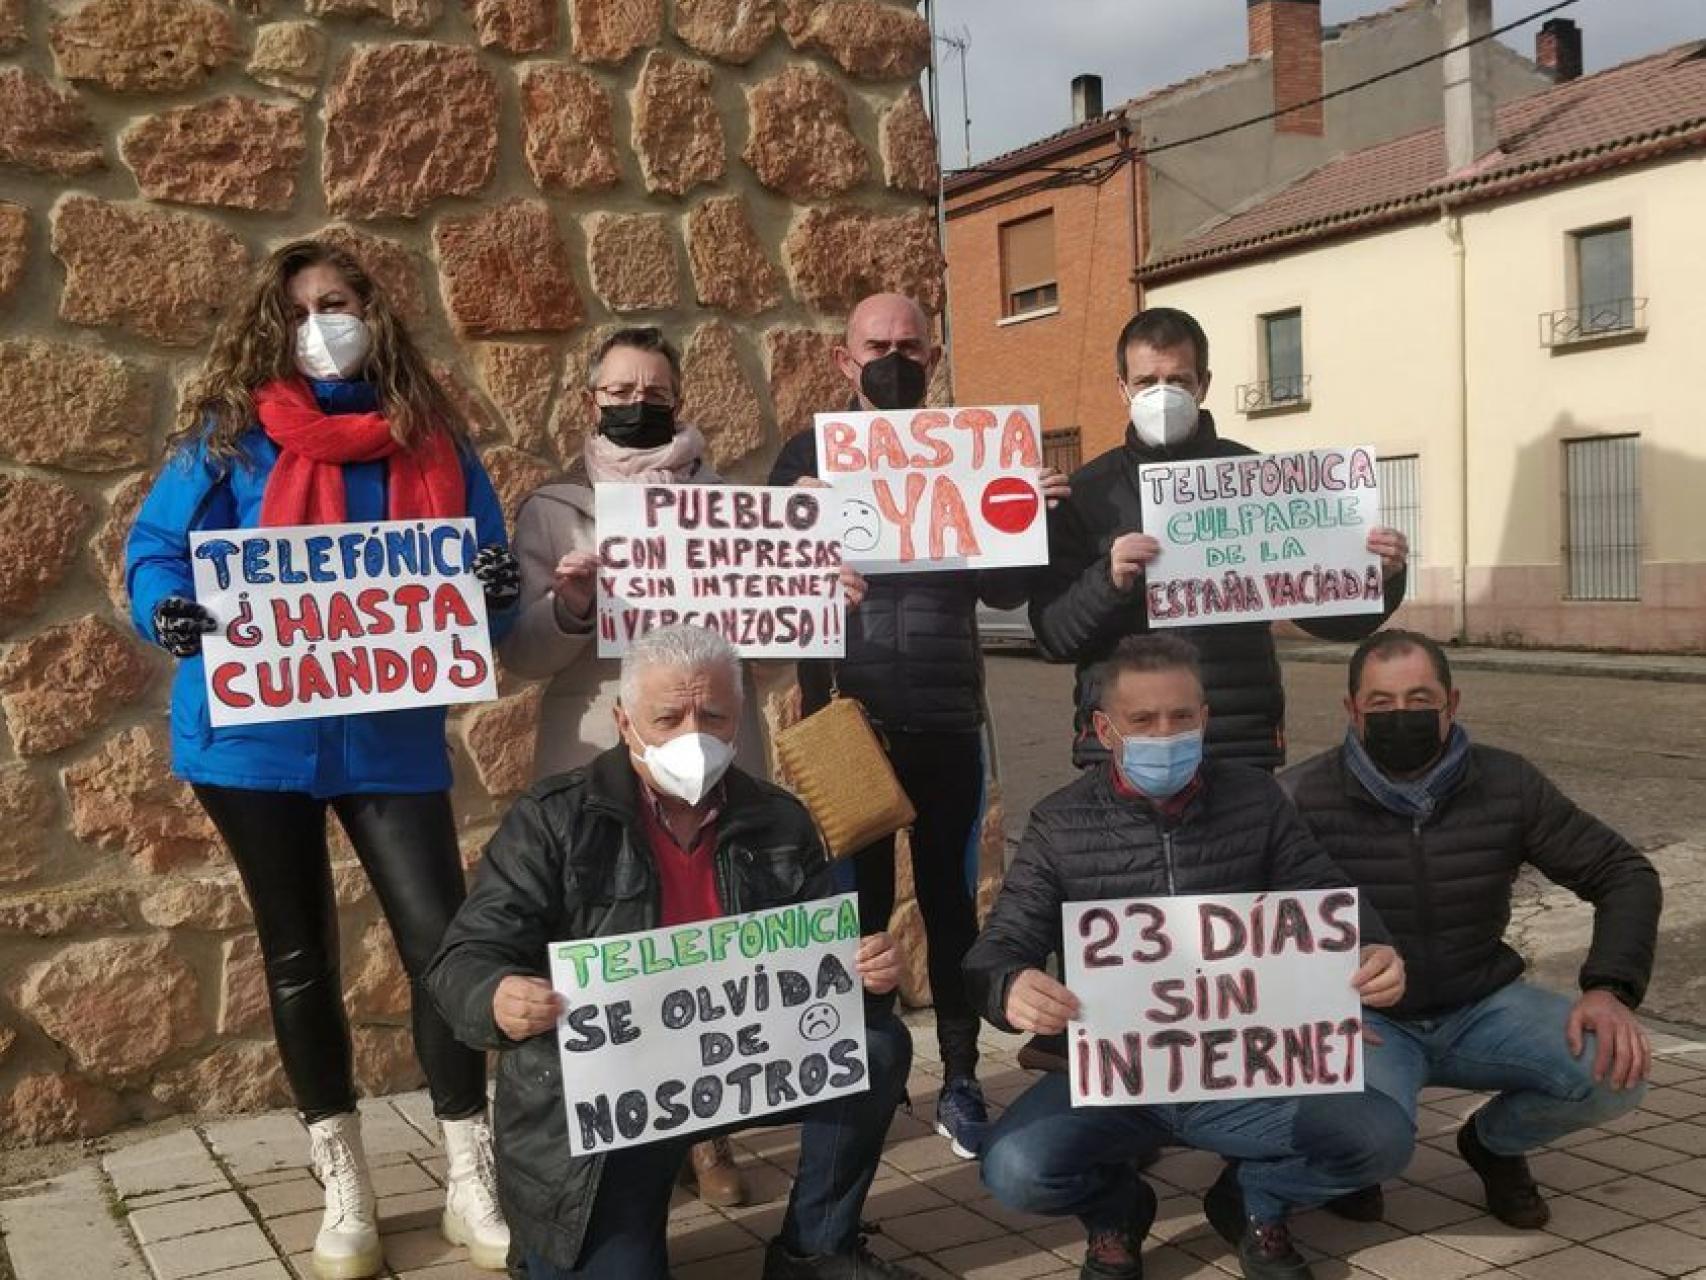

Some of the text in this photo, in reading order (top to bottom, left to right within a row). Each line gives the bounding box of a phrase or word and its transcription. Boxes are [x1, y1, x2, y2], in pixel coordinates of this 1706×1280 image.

[823, 409, 1041, 472] BASTA
[1142, 448, 1377, 505] TELEFÓNICA
[645, 487, 819, 531] PUEBLO
[872, 472, 982, 563] YA
[1167, 496, 1364, 545] CULPABLE
[600, 535, 843, 569] CON EMPRESAS
[1205, 536, 1306, 568] DE LA
[600, 571, 841, 598] Y SIN INTERNET
[1146, 570, 1264, 620] ESPAÑA
[559, 898, 859, 988] TELEFÓNICA
[1078, 892, 1357, 968] 23 DÍAS
[564, 953, 852, 1051] SE OLVIDA
[1145, 967, 1258, 1023] SIN
[699, 1022, 769, 1066] DE
[1077, 1017, 1361, 1097] INTERNET
[575, 1038, 865, 1150] NOSOTROS
